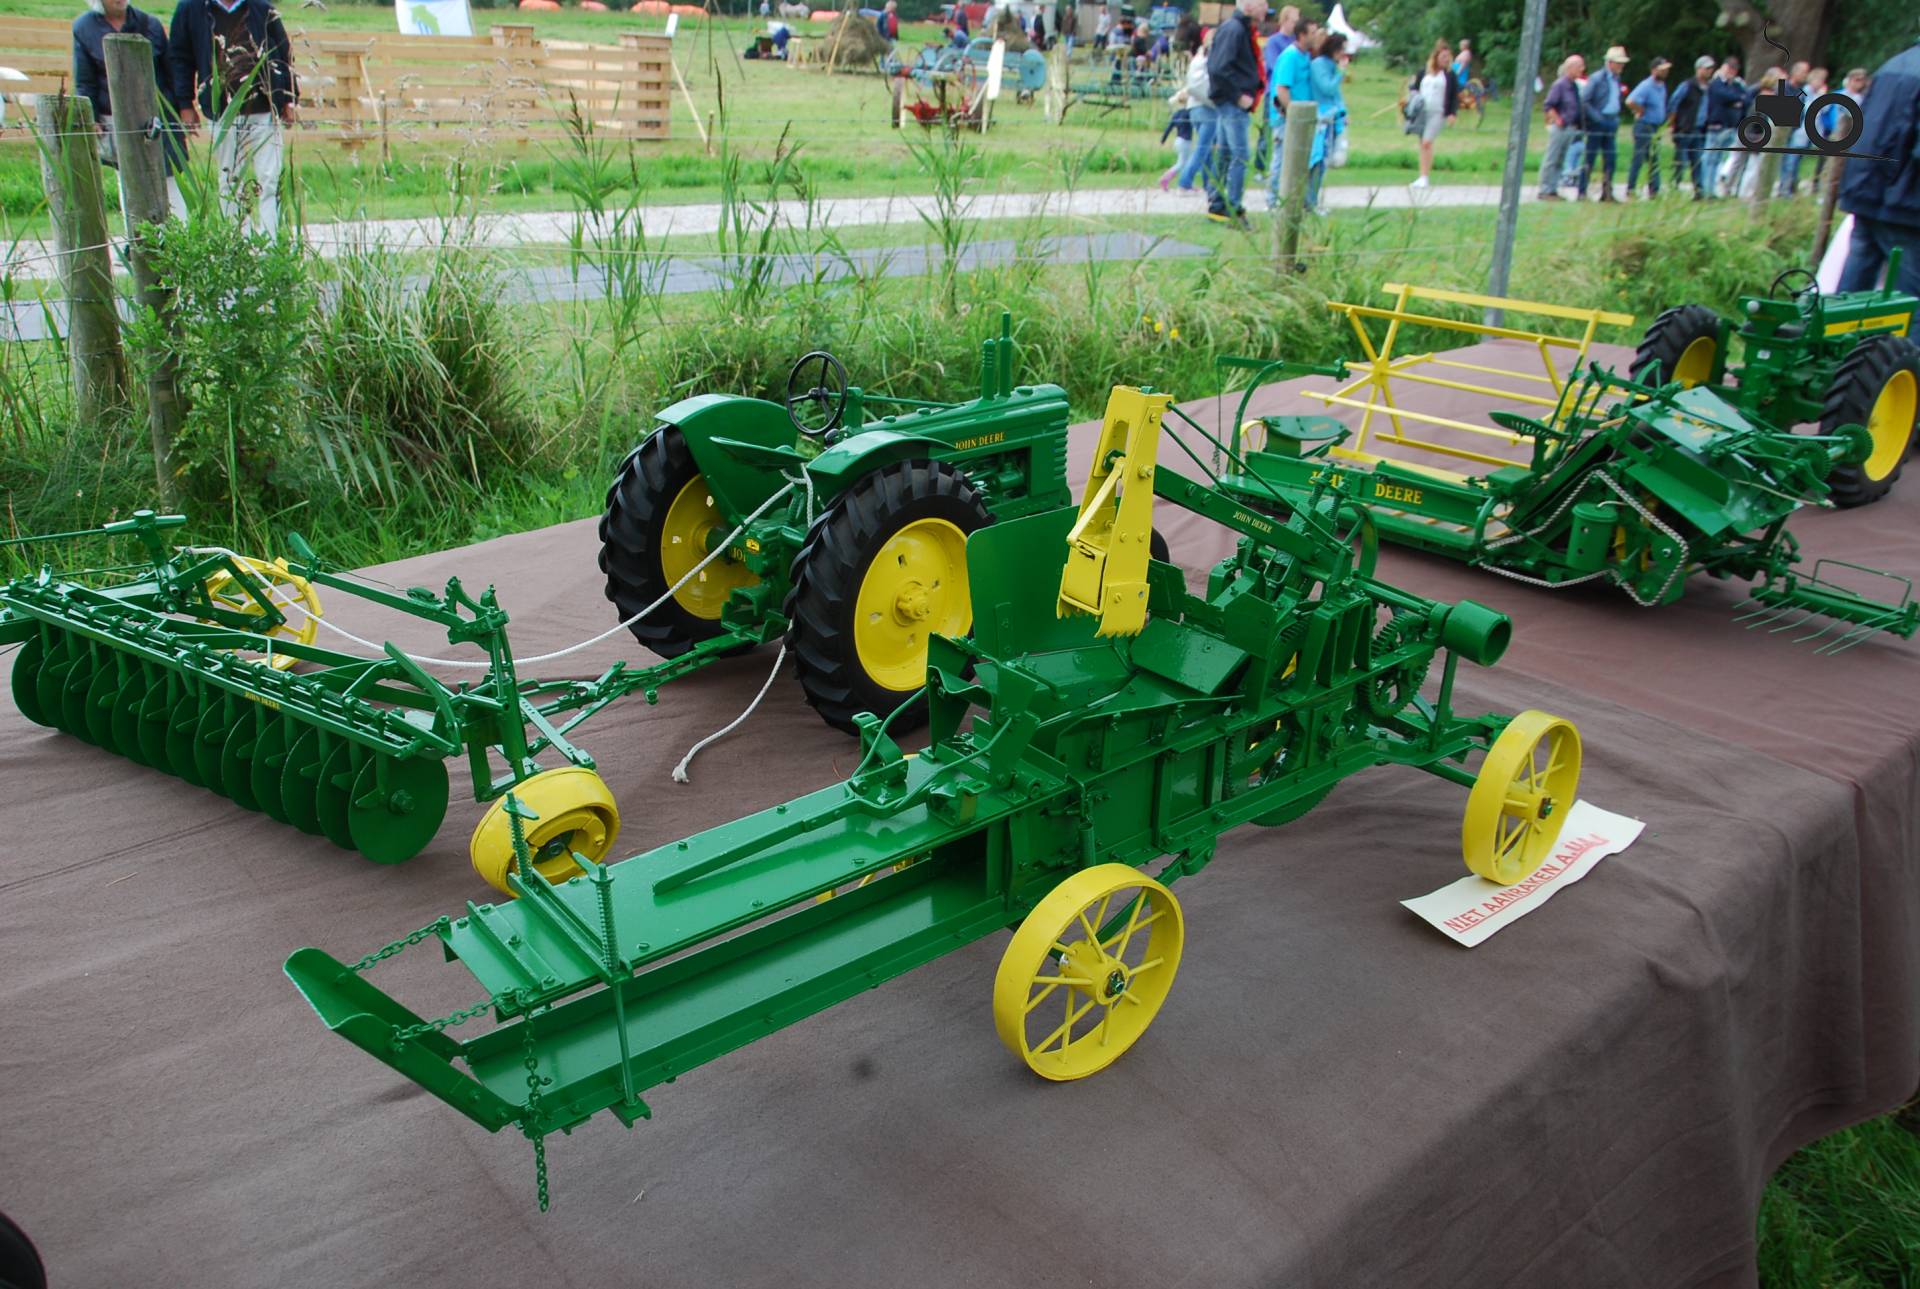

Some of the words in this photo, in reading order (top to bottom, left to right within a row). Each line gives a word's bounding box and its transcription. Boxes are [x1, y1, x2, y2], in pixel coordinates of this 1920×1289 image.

[955, 439, 977, 450] JOHN
[979, 431, 1005, 446] DEERE
[1375, 483, 1423, 504] DEERE
[1233, 511, 1252, 524] JOHN
[1251, 518, 1273, 534] DEERE
[1443, 908, 1485, 932] NIET
[1482, 863, 1561, 913] AANRAKEN
